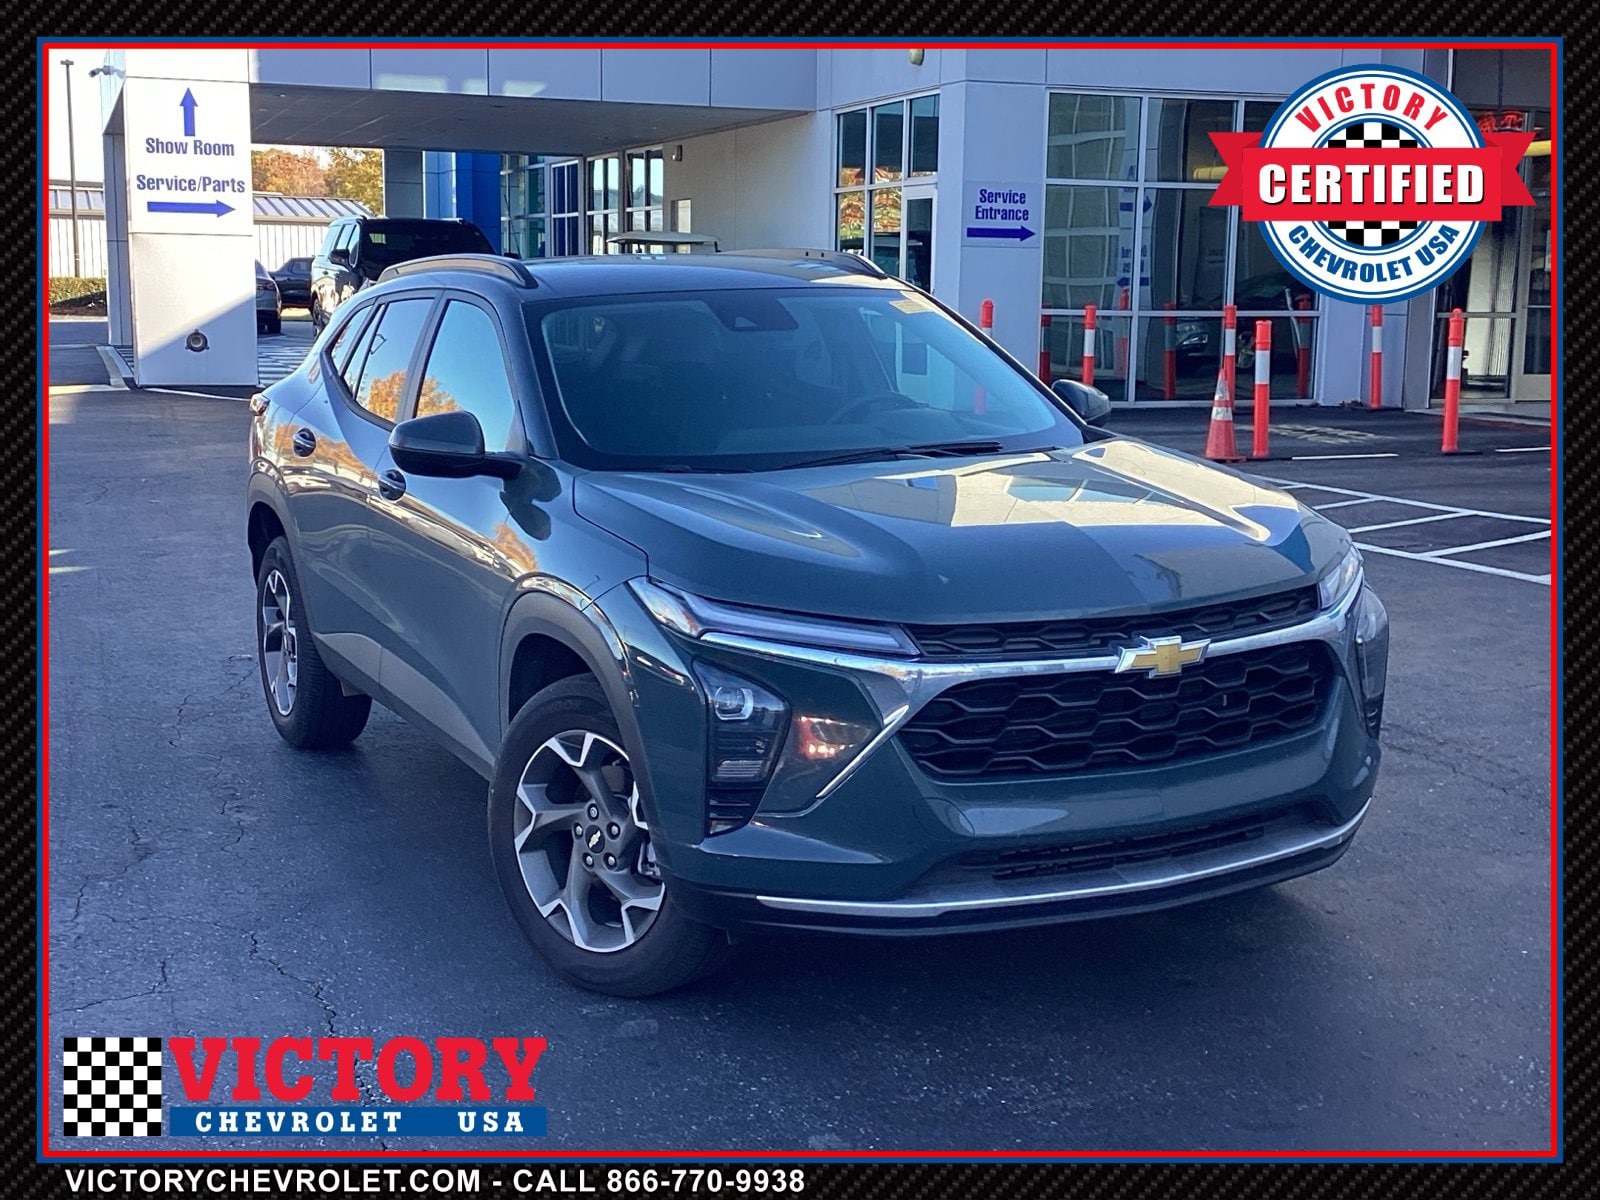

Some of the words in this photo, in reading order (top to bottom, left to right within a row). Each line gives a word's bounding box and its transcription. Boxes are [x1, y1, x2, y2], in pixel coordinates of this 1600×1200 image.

[145, 137, 188, 155] Show
[192, 139, 235, 156] Room
[136, 174, 246, 193] Service/Parts
[979, 188, 1027, 204] Service
[974, 205, 1030, 222] Entrance
